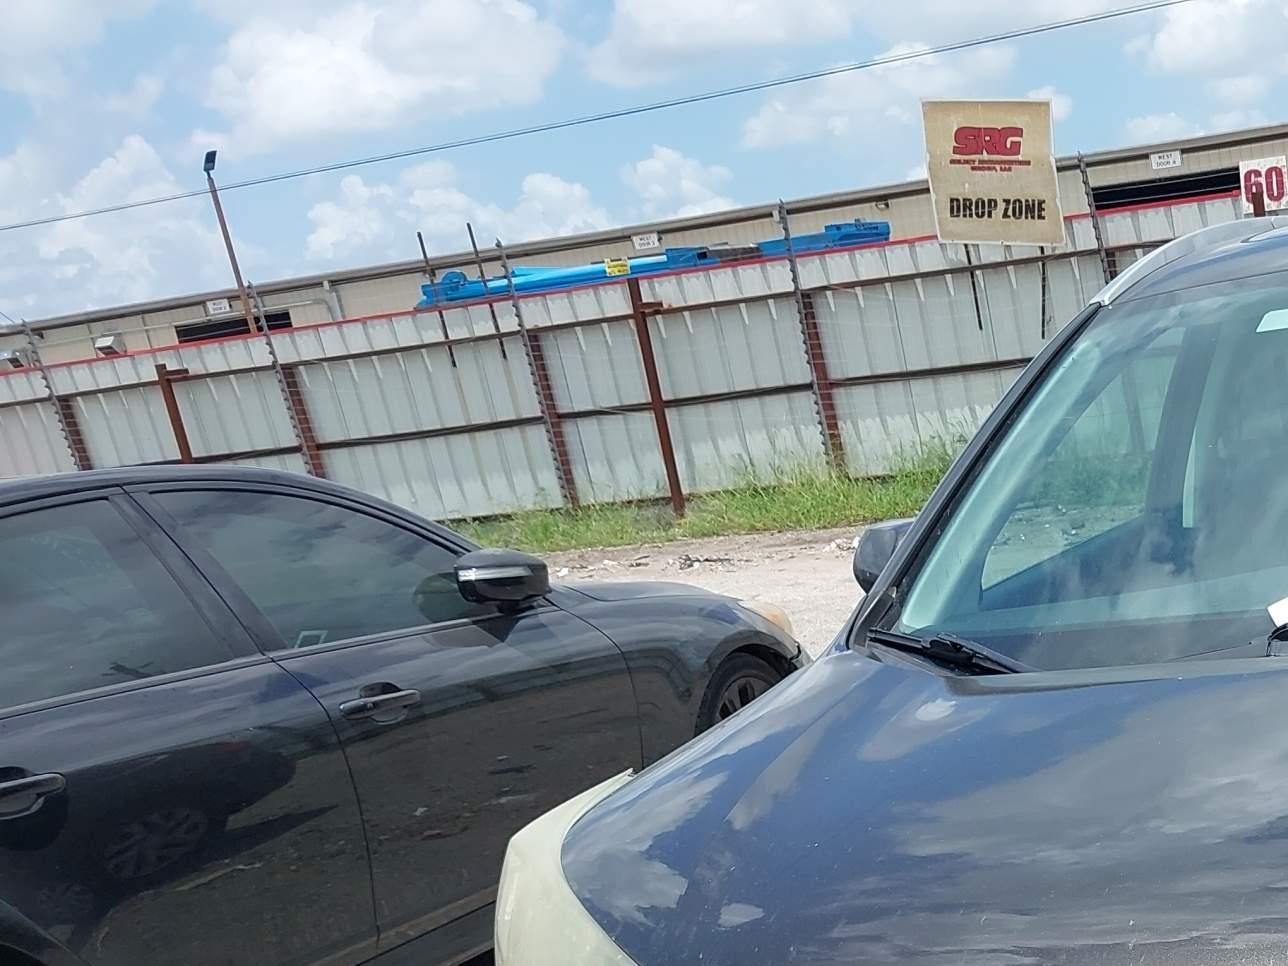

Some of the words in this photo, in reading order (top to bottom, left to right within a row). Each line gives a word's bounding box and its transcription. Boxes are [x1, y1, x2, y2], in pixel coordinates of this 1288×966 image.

[952, 126, 1023, 156] SRG
[1243, 165, 1285, 204] 60
[949, 197, 998, 219] DROP
[1001, 198, 1046, 221] ZONE
